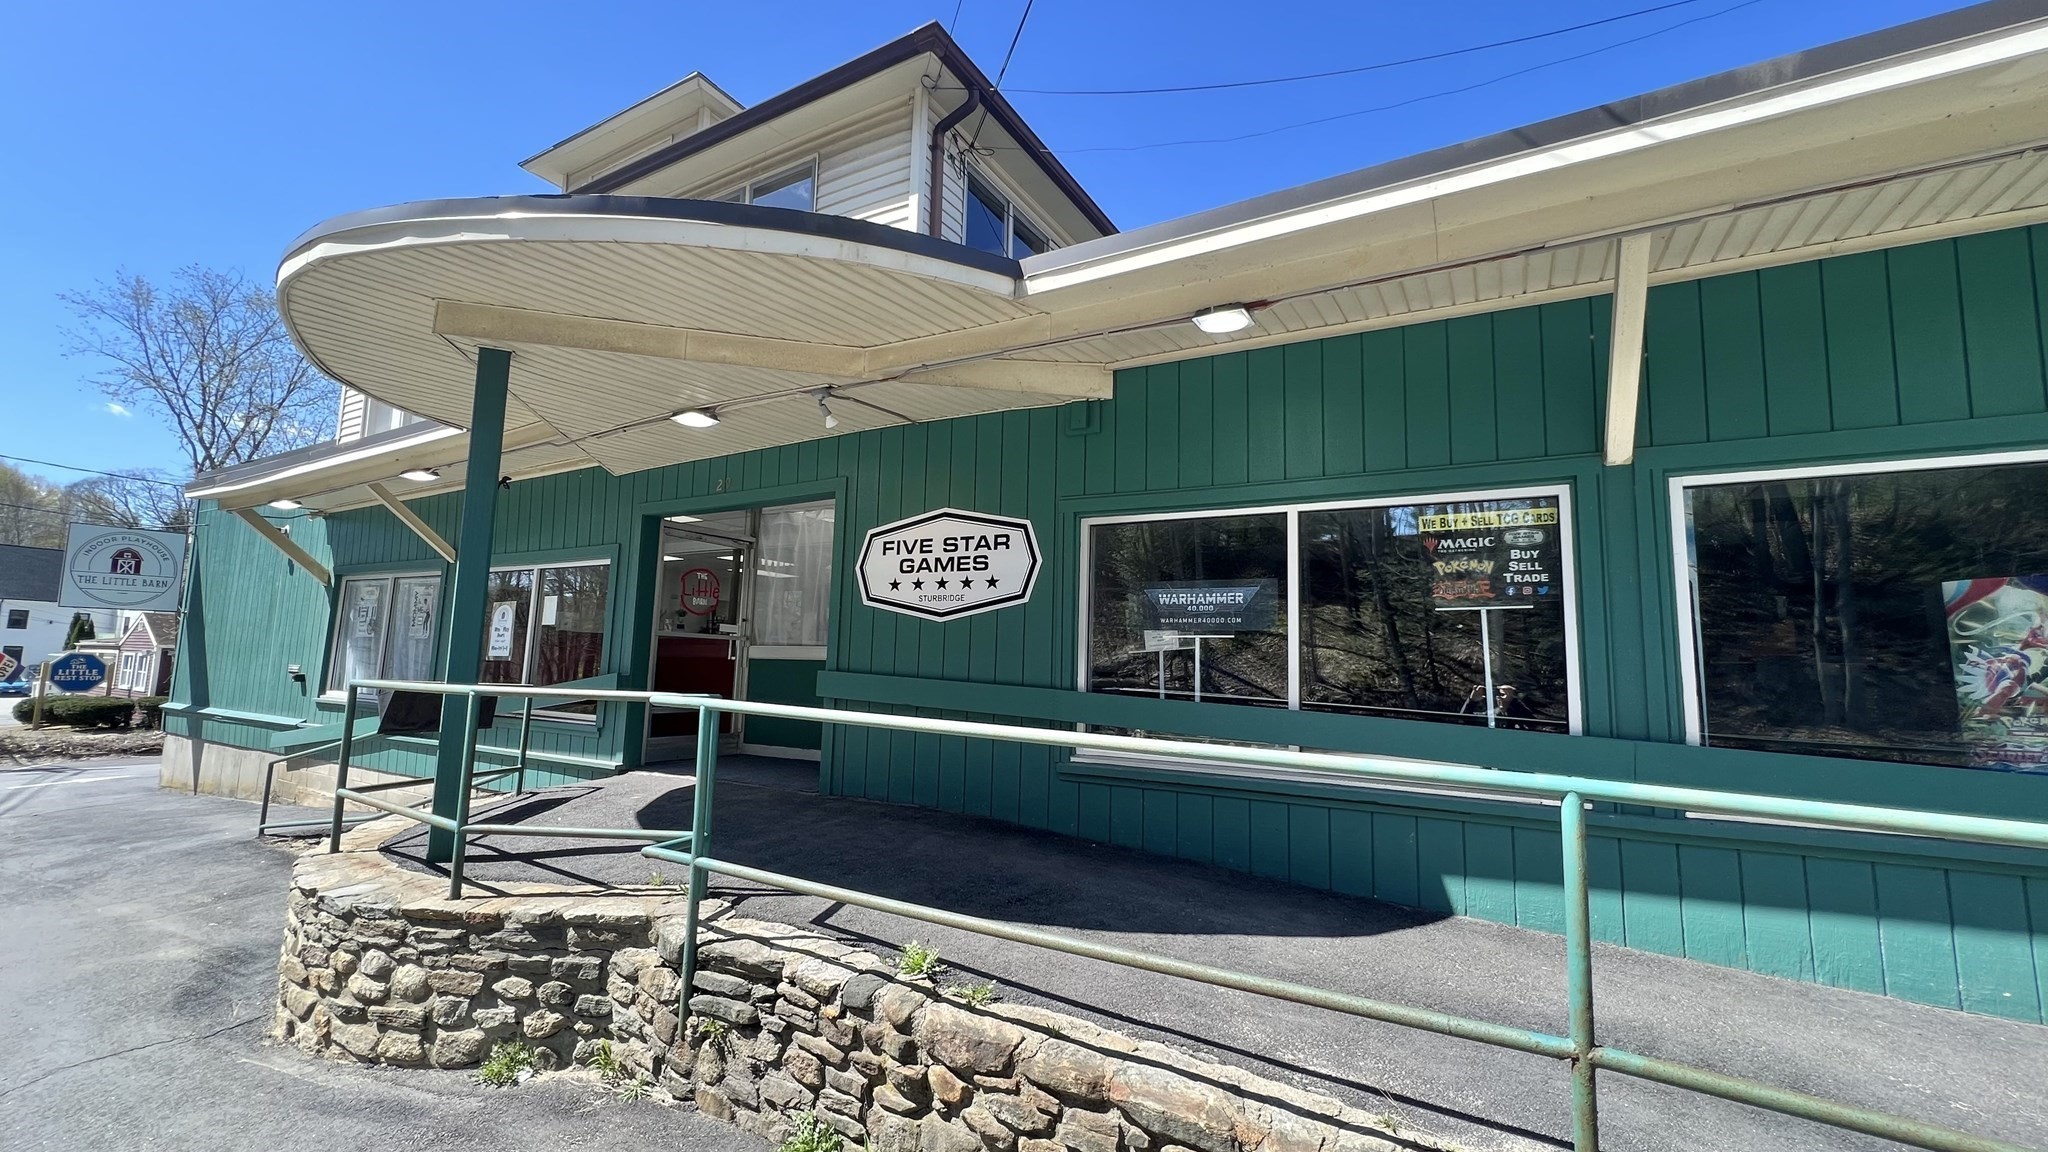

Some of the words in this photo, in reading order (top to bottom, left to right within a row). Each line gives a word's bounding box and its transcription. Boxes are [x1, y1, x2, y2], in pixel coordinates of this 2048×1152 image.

[1440, 517, 1458, 528] BUY
[1471, 515, 1493, 527] SELL
[1497, 512, 1519, 525] TCG
[1522, 511, 1555, 525] CARDS
[83, 536, 117, 556] INDOOR
[121, 535, 170, 562] PLAYHOUSE
[882, 538, 934, 556] FIVE
[942, 533, 1011, 553] STAR
[1437, 536, 1496, 550] MAGIC
[1510, 549, 1540, 560] BUY
[899, 554, 989, 574] GAMES
[1508, 561, 1543, 571] SELL
[77, 574, 98, 584] THE
[102, 576, 137, 587] LITTLE
[142, 579, 168, 589] BARN
[1503, 573, 1549, 583] TRADE
[918, 594, 965, 603] STURBRIDGE
[1158, 592, 1244, 605] WARHAMMER
[1160, 616, 1242, 624] WARHAMMER40000.COM
